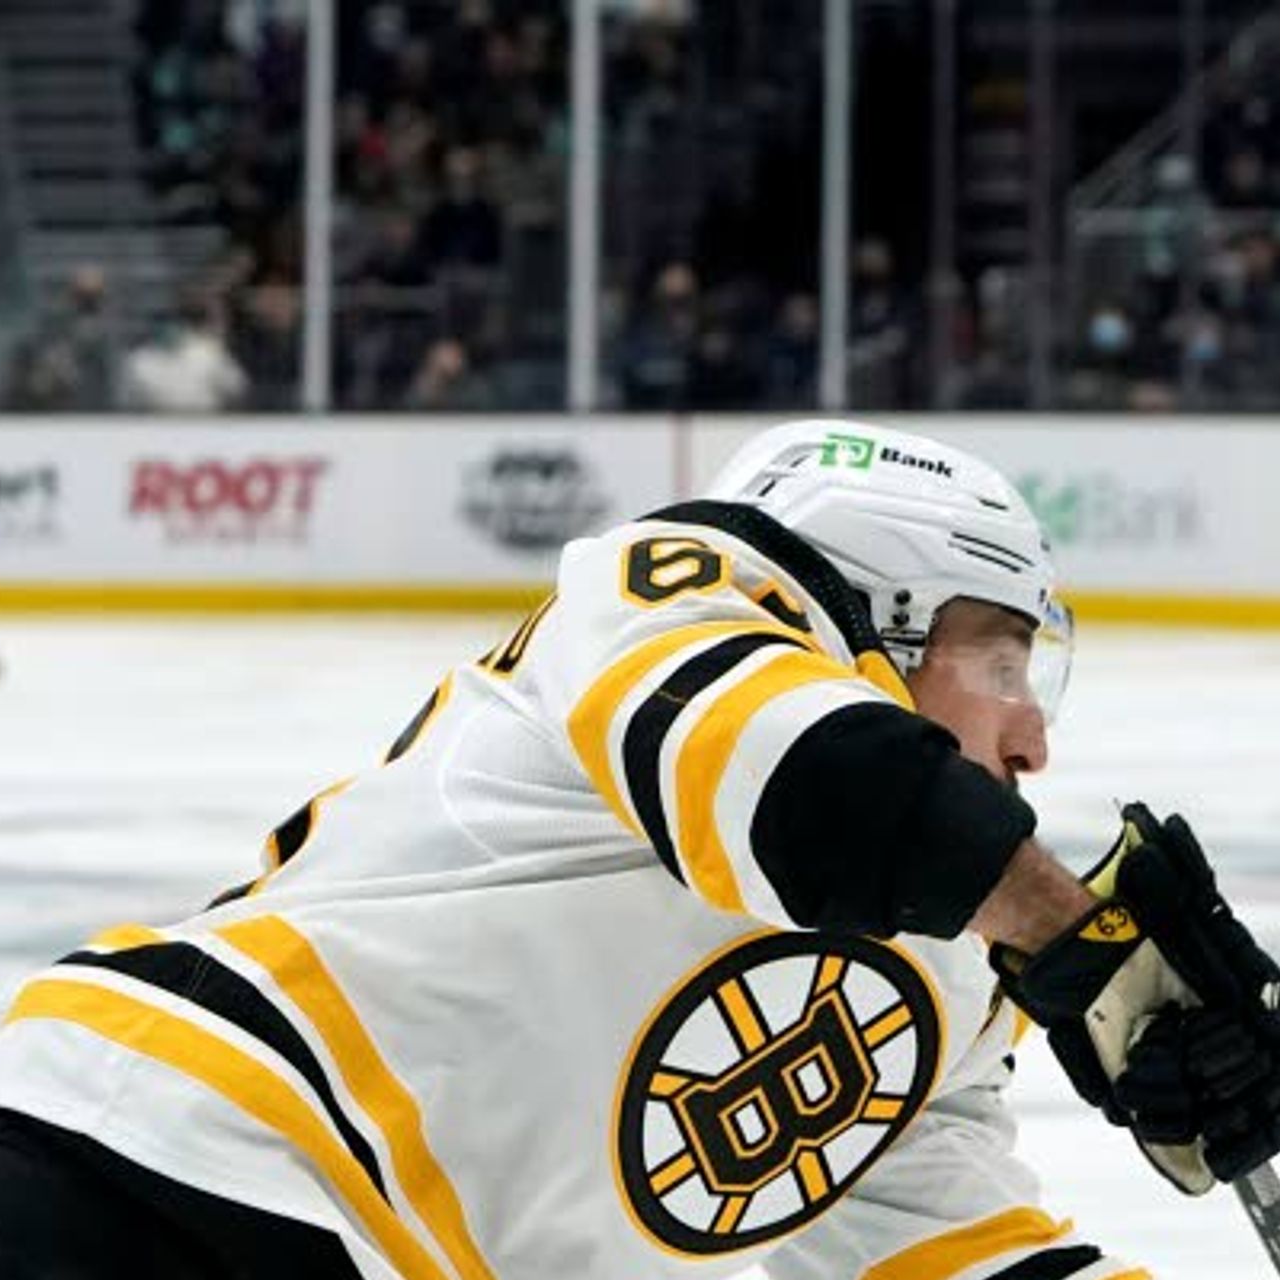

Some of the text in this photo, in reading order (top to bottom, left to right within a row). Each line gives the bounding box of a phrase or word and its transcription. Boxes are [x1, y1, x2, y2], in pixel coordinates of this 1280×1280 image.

[126, 456, 330, 518] ROOT
[880, 446, 953, 479] Bank
[671, 987, 878, 1195] B
